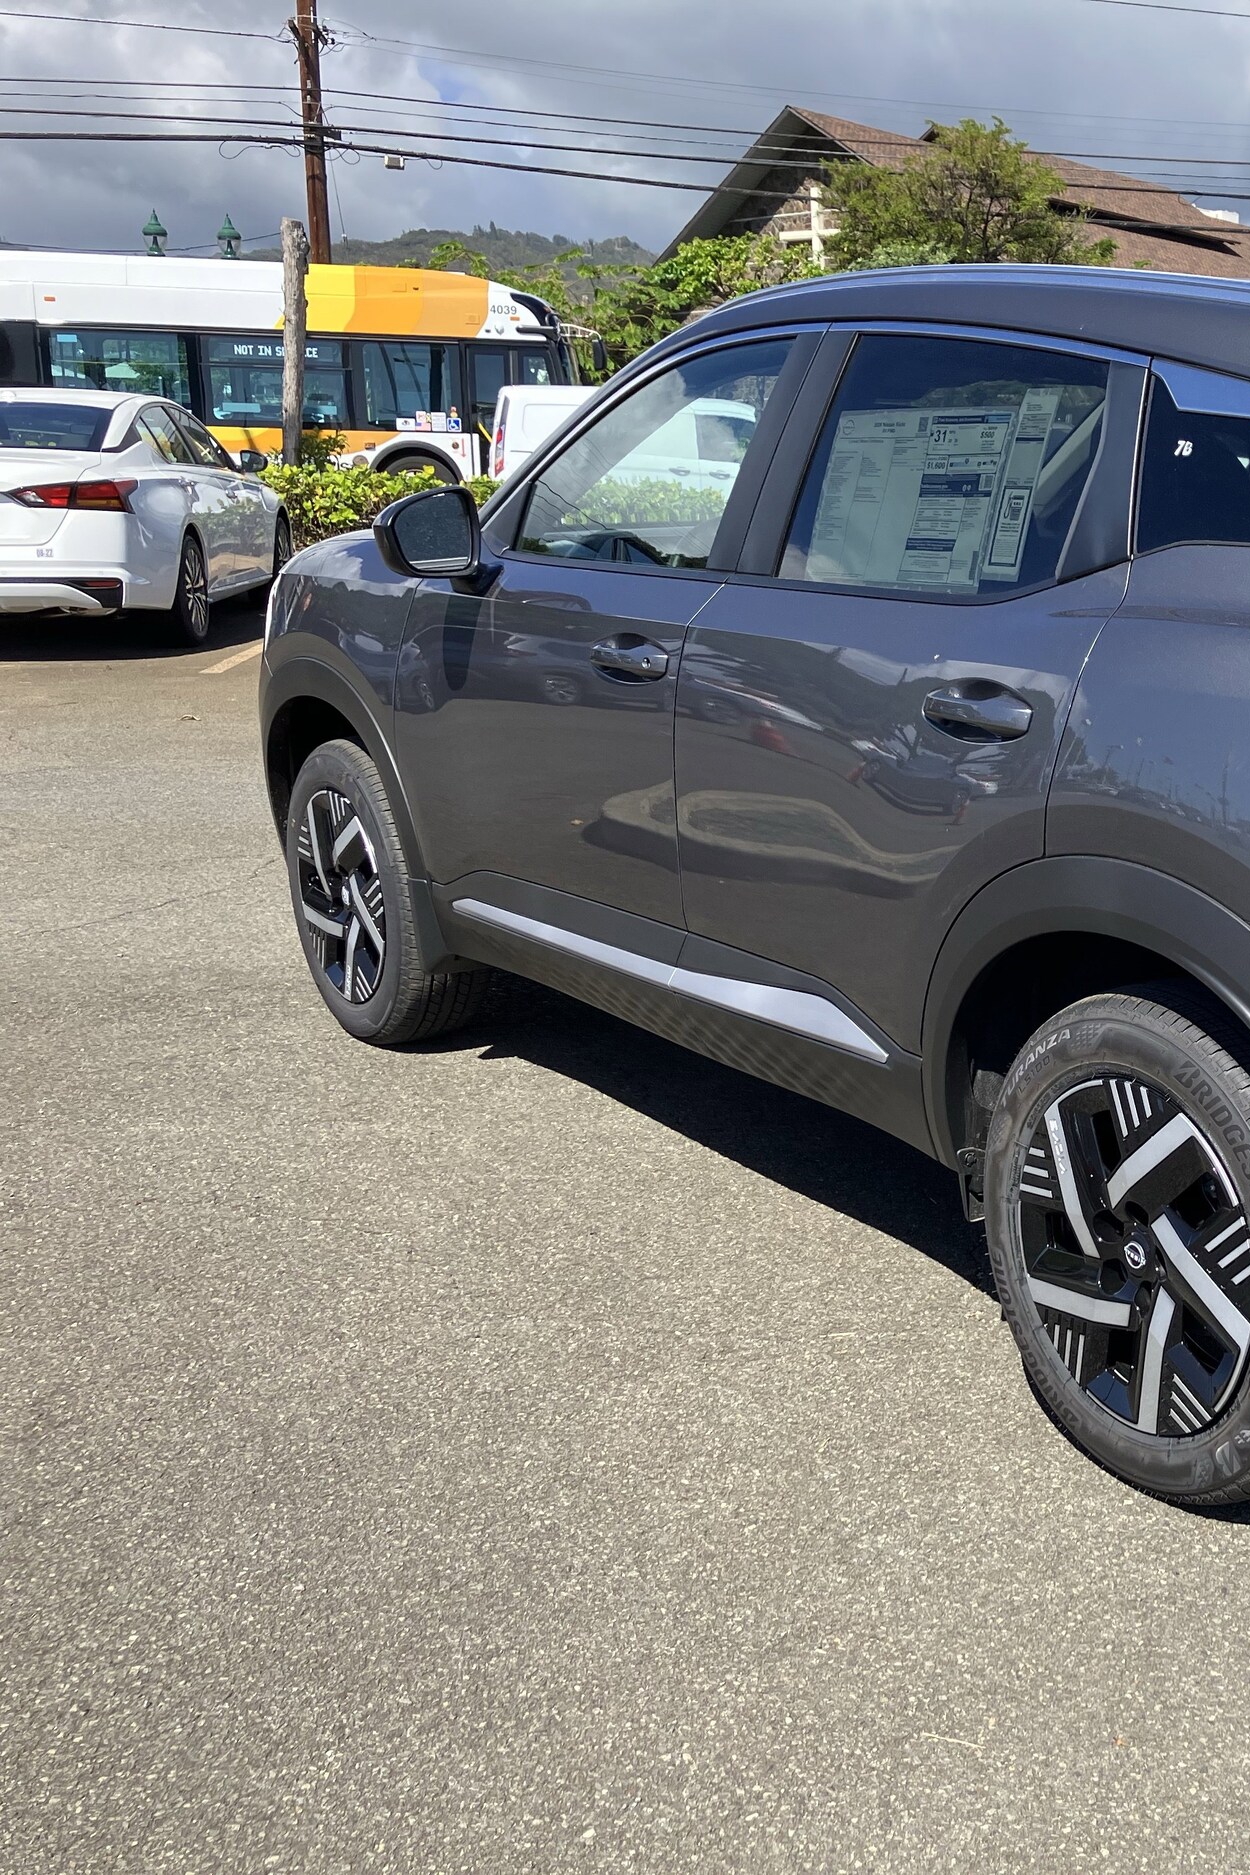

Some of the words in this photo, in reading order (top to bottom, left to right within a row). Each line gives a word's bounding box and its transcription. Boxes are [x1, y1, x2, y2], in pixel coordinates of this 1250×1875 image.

[490, 305, 517, 315] 4039
[233, 344, 254, 356] NOT
[258, 345, 272, 356] IN
[934, 429, 947, 443] 31
[1001, 1028, 1071, 1107] TURANZA
[991, 1250, 1082, 1431] BRIDGESTONE
